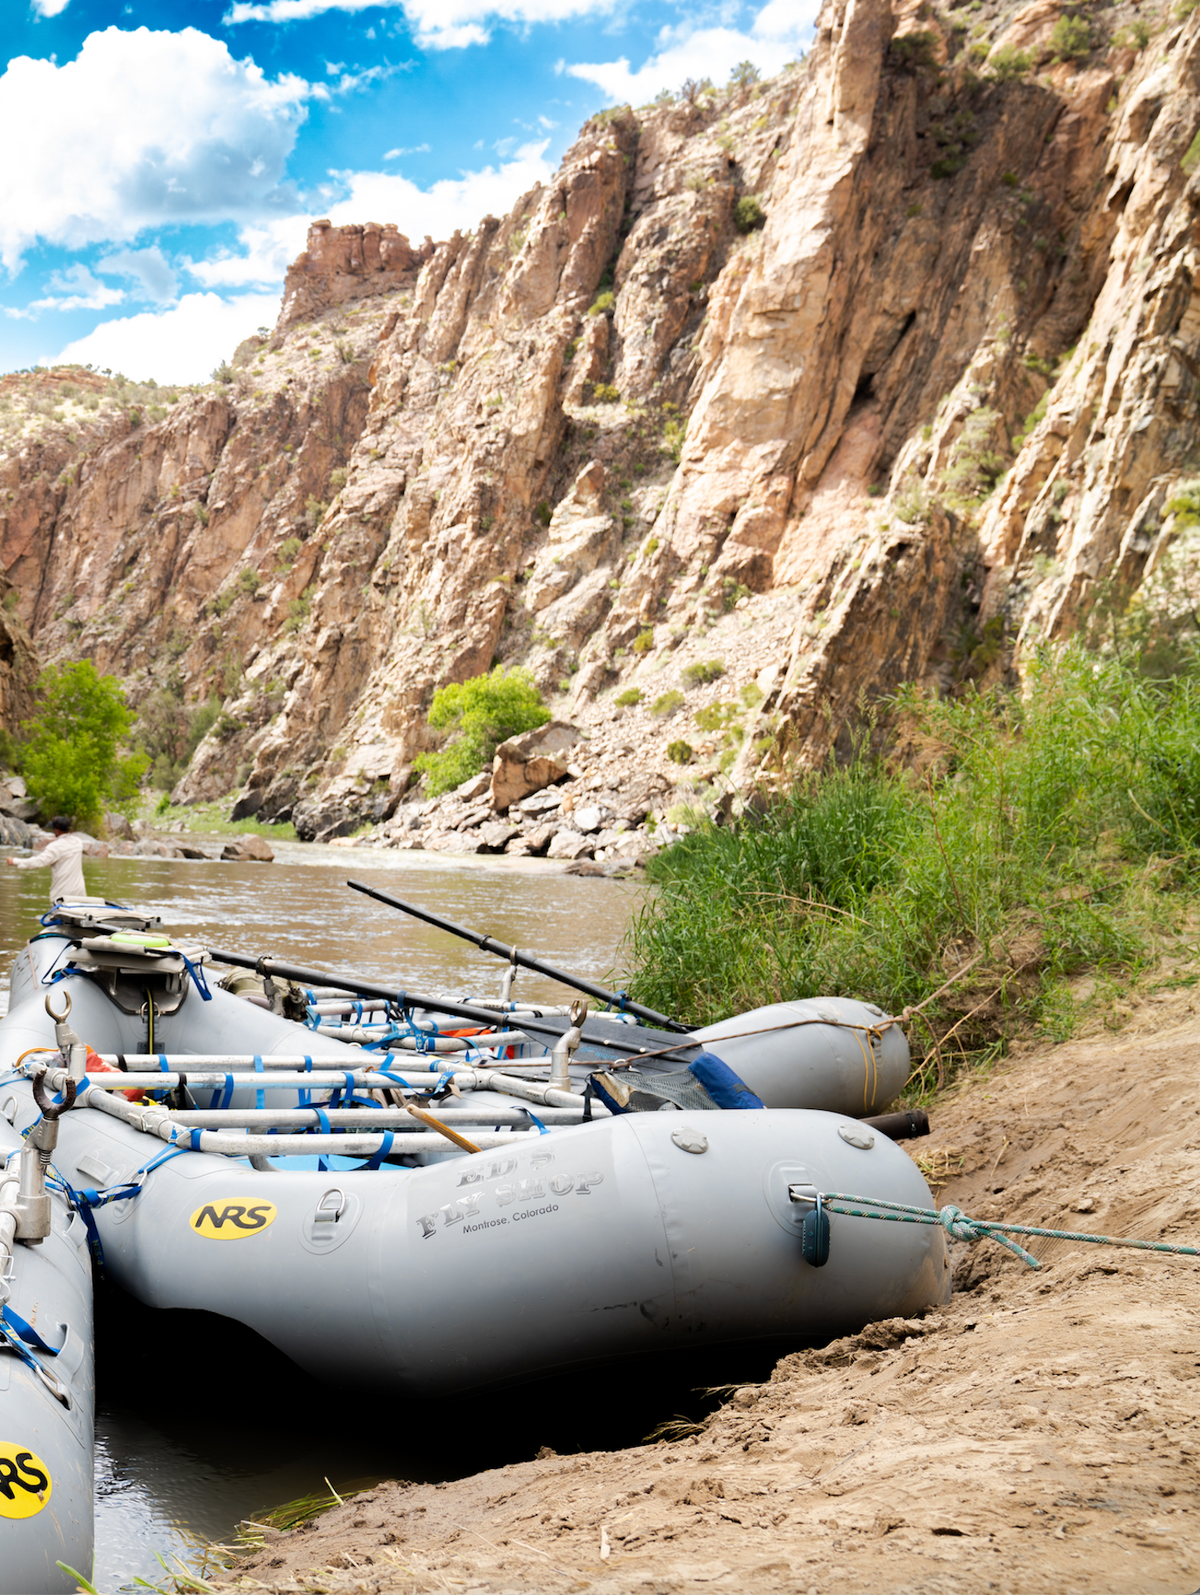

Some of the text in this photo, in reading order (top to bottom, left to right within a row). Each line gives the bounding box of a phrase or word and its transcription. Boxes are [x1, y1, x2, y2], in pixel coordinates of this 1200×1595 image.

[456, 1146, 556, 1189] ED'S
[195, 1205, 272, 1229] NRS
[415, 1171, 605, 1240] FLY SHOP
[462, 1203, 560, 1234] Montrose, Colorado
